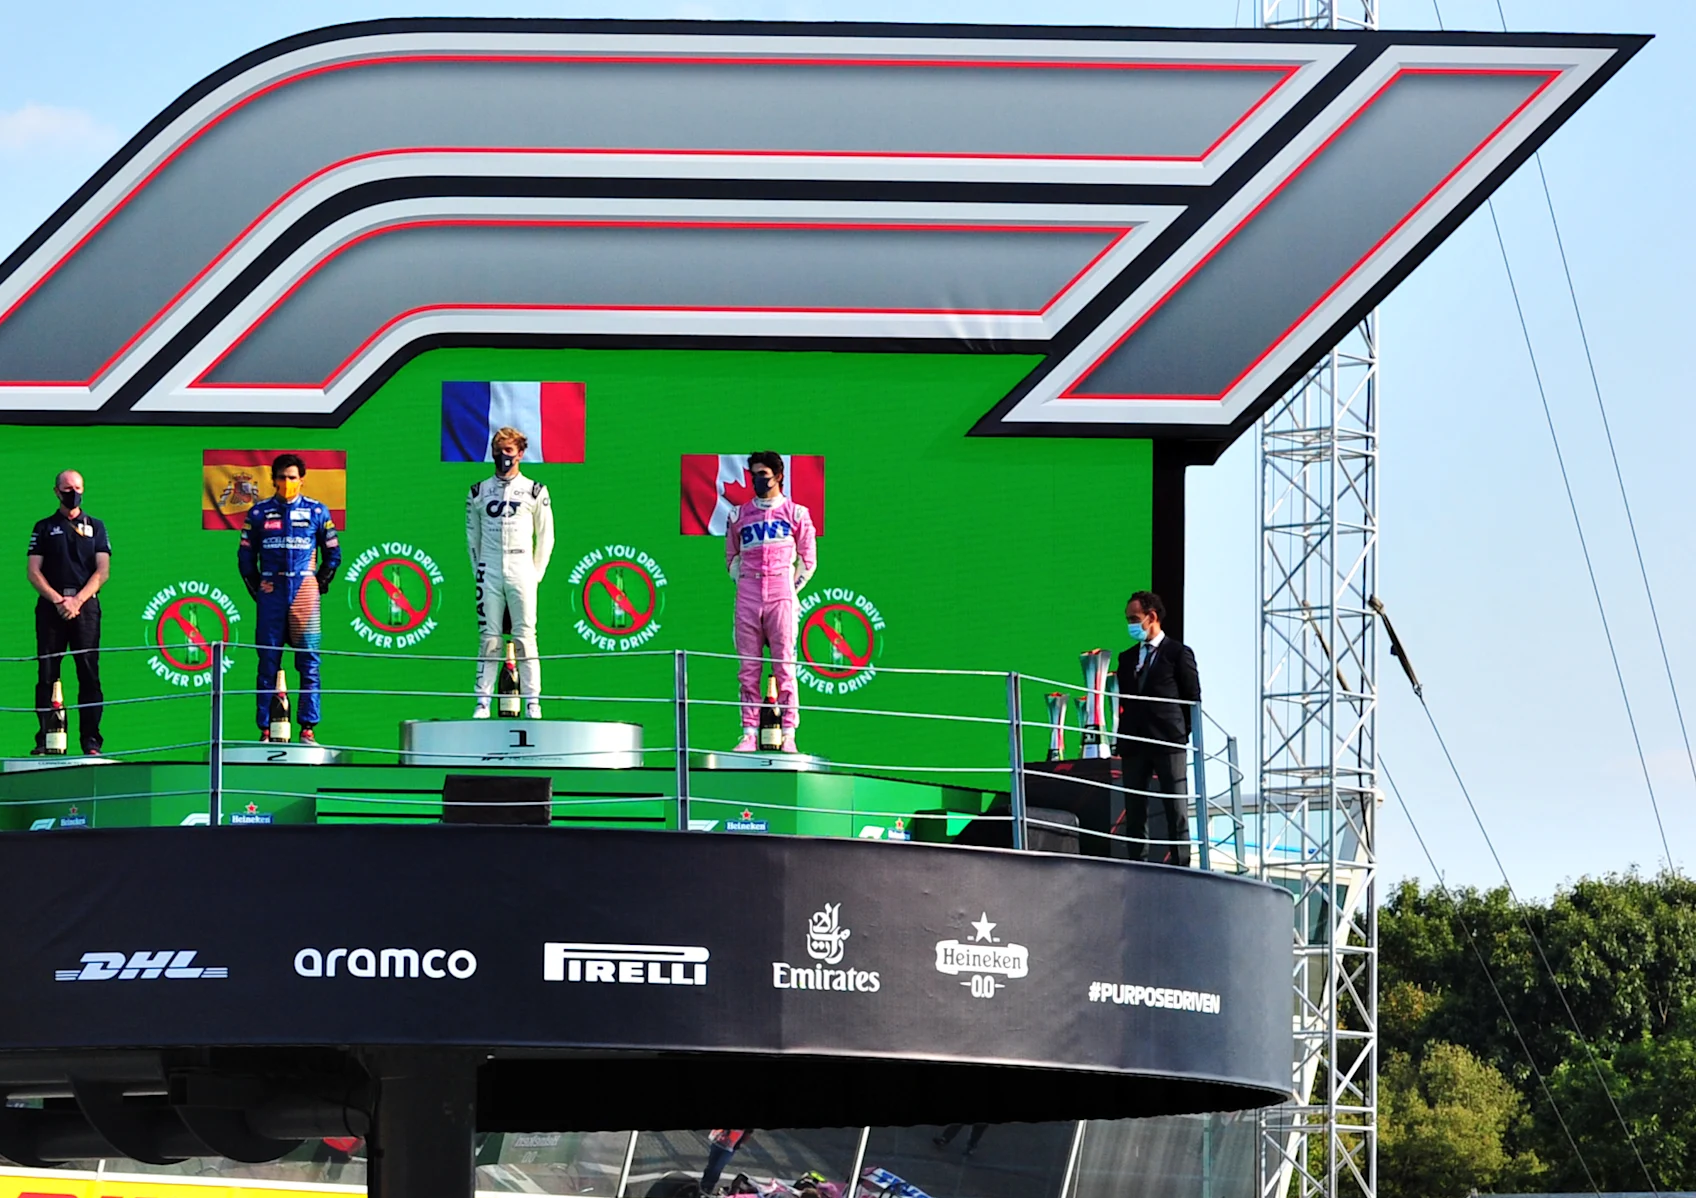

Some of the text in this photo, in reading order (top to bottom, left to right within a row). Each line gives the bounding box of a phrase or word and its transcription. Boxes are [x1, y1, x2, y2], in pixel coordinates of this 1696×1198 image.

[345, 542, 444, 585] WHEN YOU DRIVE
[568, 545, 668, 588] WHEN YOU DRIVE
[142, 581, 241, 624] WHEN YOU DRIVE
[798, 588, 886, 631] HEN YOU DRIVE
[350, 617, 438, 648] NEVER DRINK
[573, 619, 661, 651] NEVER DRINK
[147, 656, 235, 687] NEVER DRK
[795, 664, 834, 694] NEVER
[509, 730, 535, 748] 1
[266, 750, 288, 761] 2
[232, 814, 272, 825] Heineken
[727, 820, 767, 832] Heineken
[77, 950, 205, 980] DHL
[293, 948, 477, 979] aramco
[544, 942, 710, 985] PIRELLI
[943, 948, 1021, 970] Heineken
[772, 962, 880, 992] Emirates
[971, 974, 995, 998] 0.0
[1088, 981, 1220, 1014] #PURPOSEDRIVEN
